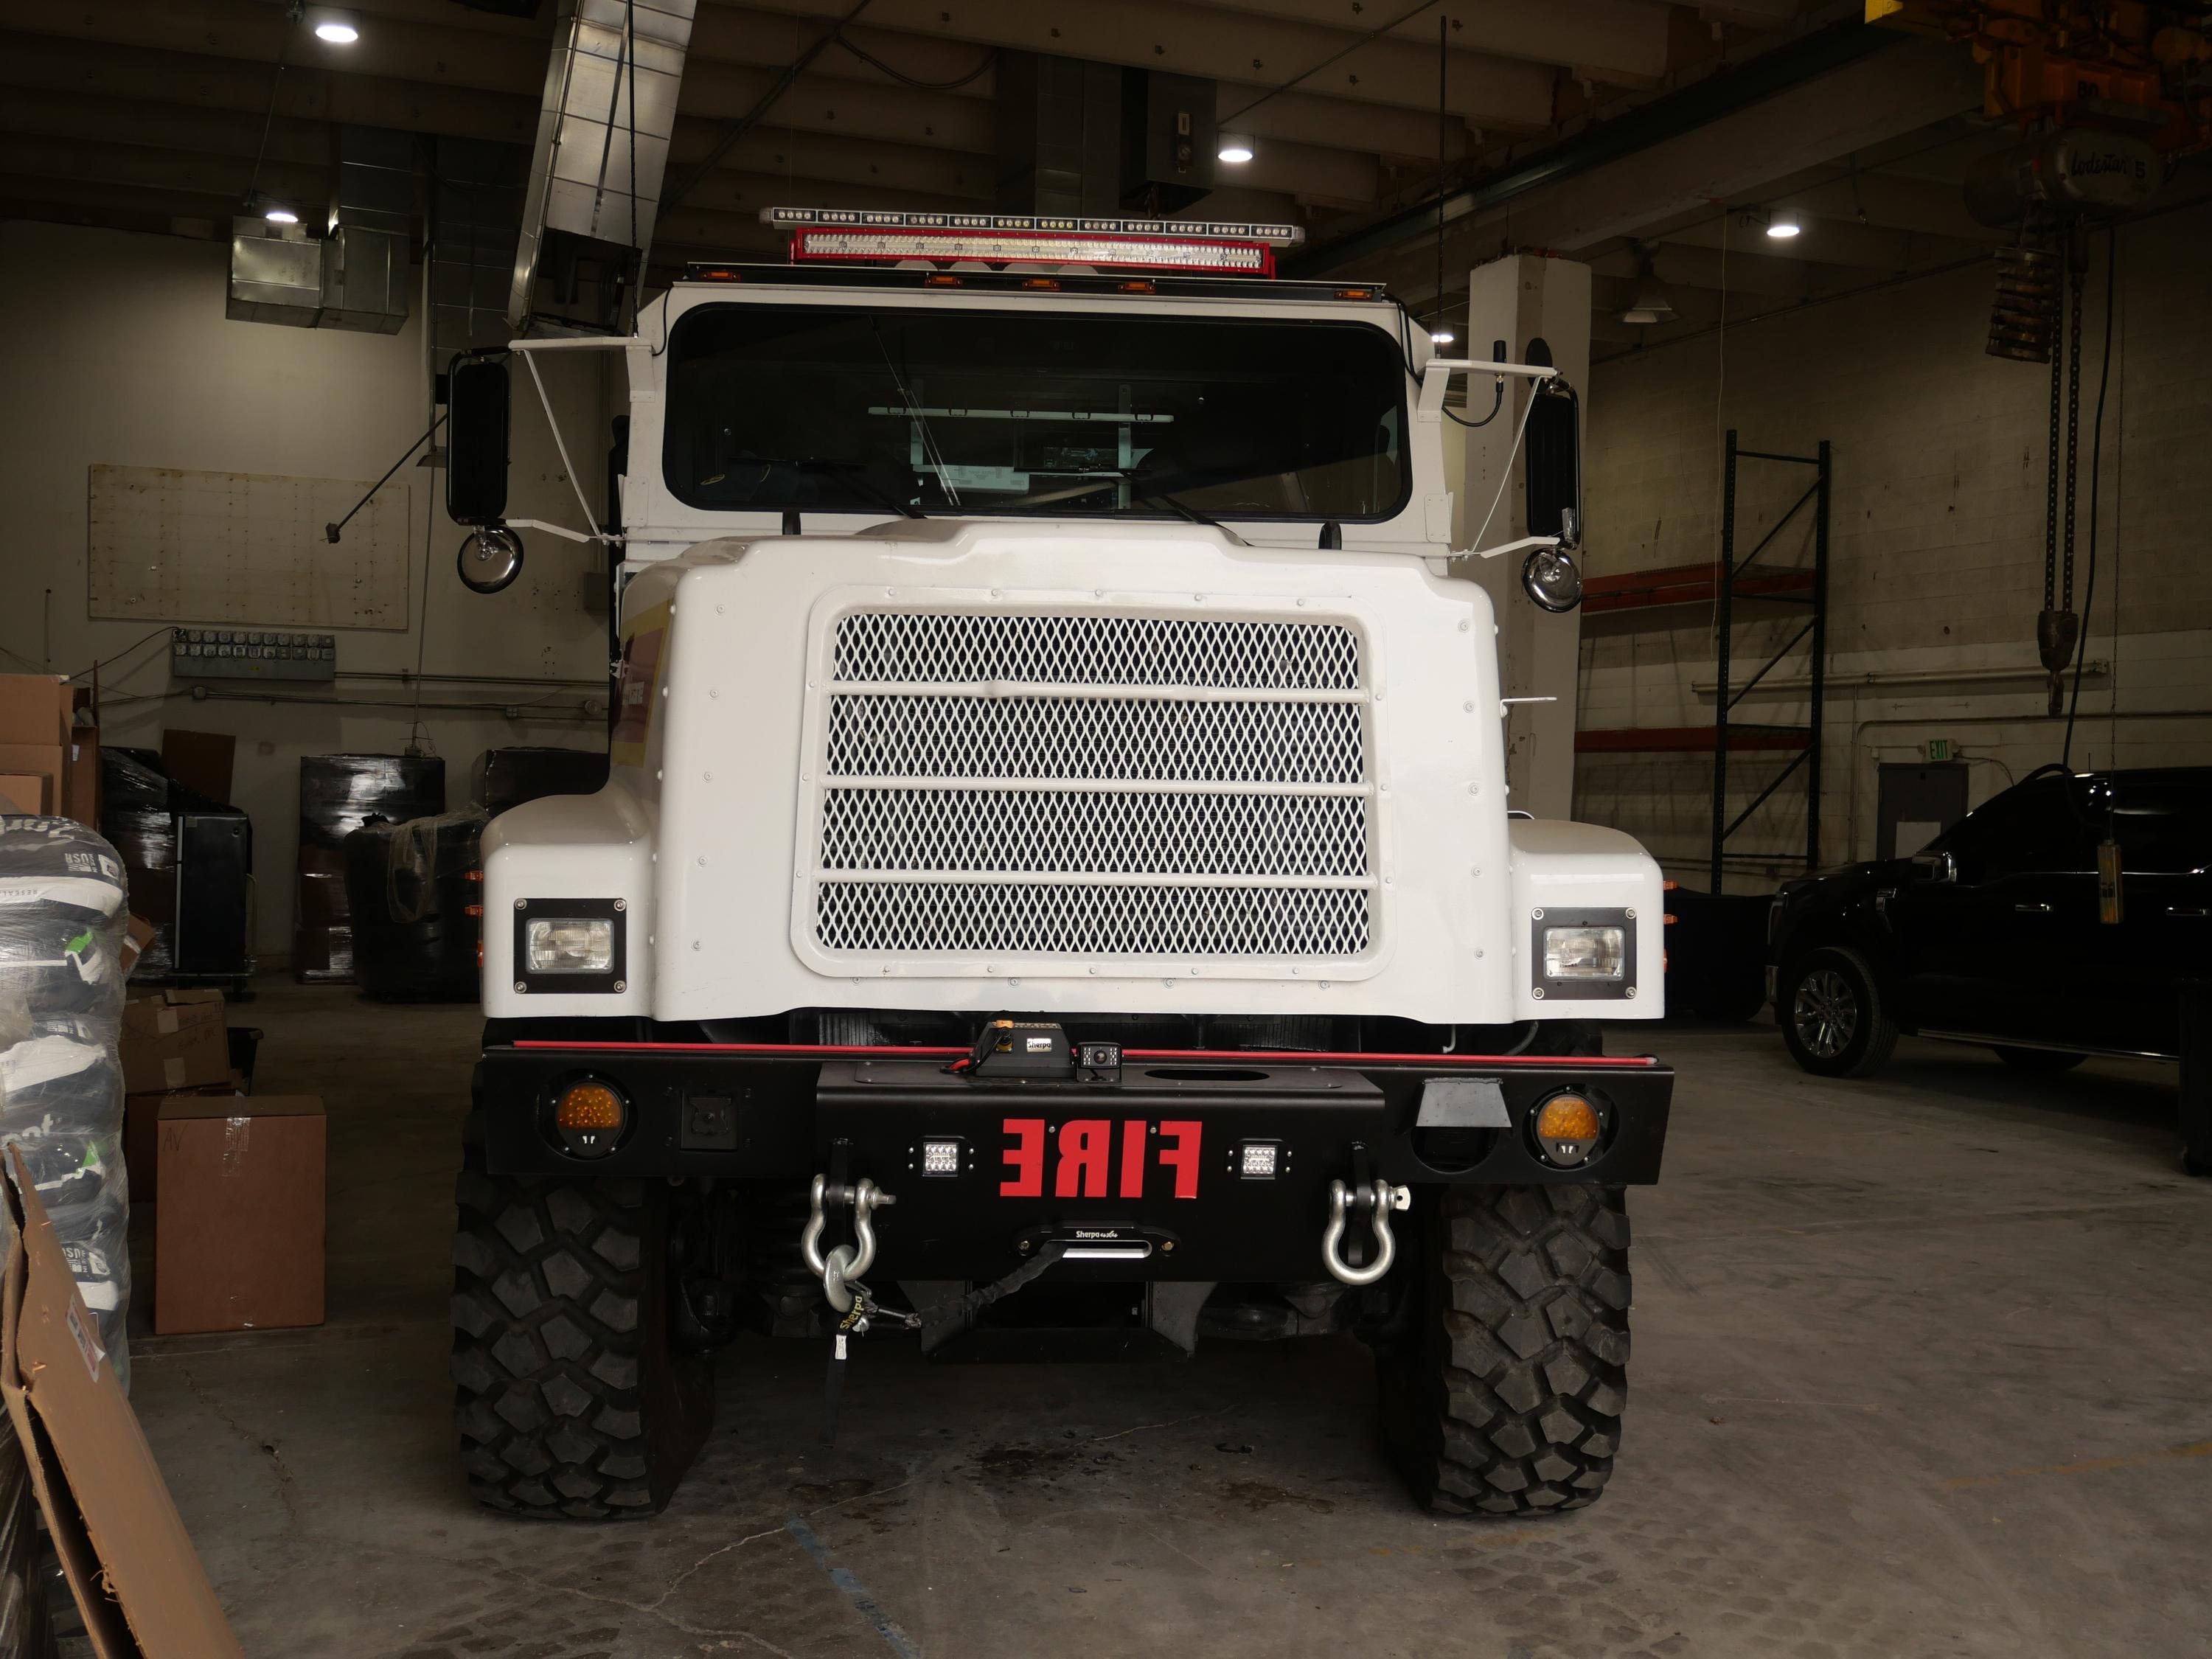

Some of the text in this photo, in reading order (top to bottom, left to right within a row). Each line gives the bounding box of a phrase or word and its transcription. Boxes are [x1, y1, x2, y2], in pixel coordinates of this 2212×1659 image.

[2071, 150, 2146, 178] Lodestar 5
[1929, 740, 1948, 759] EXIT
[65, 852, 89, 864] USA
[1027, 1040, 1051, 1049] Sherpa
[839, 1295, 865, 1331] Sherpa
